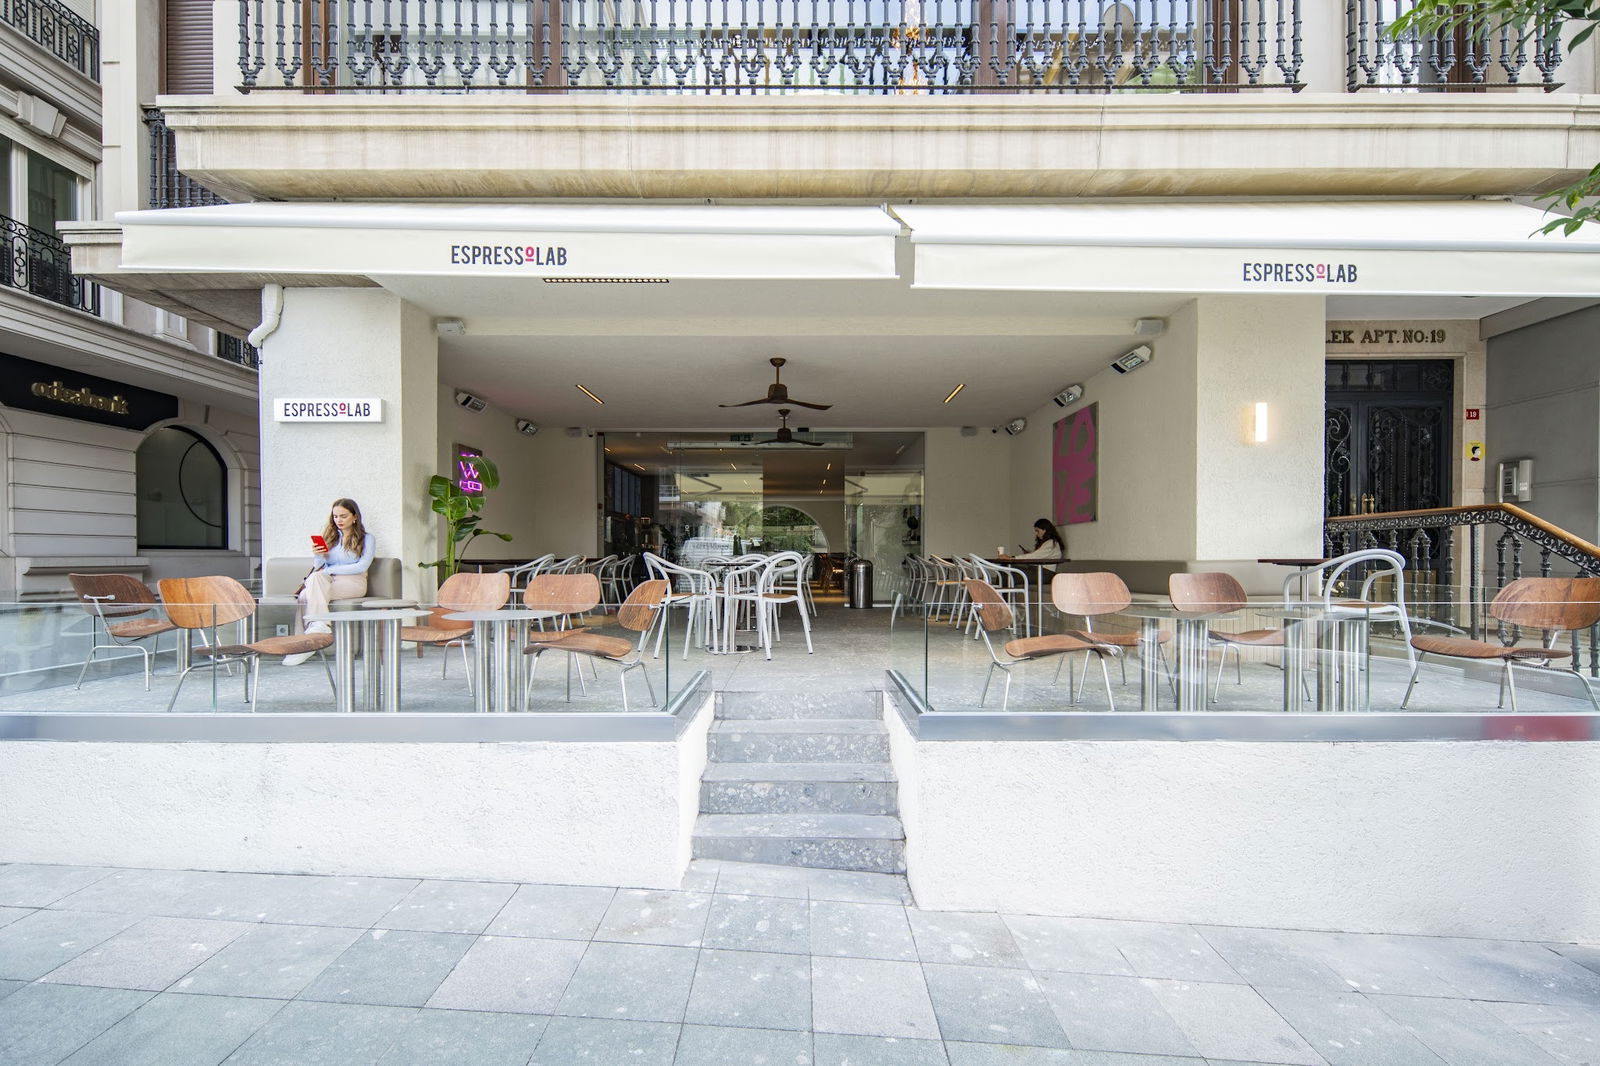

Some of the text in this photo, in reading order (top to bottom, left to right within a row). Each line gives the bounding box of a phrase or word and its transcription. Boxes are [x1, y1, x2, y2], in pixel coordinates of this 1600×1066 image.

[451, 245, 568, 266] ESPRESSOLAB
[1243, 262, 1358, 283] ESPRESSOLAB
[1325, 330, 1355, 344] EK
[284, 402, 371, 417] ESPRESSOLAB
